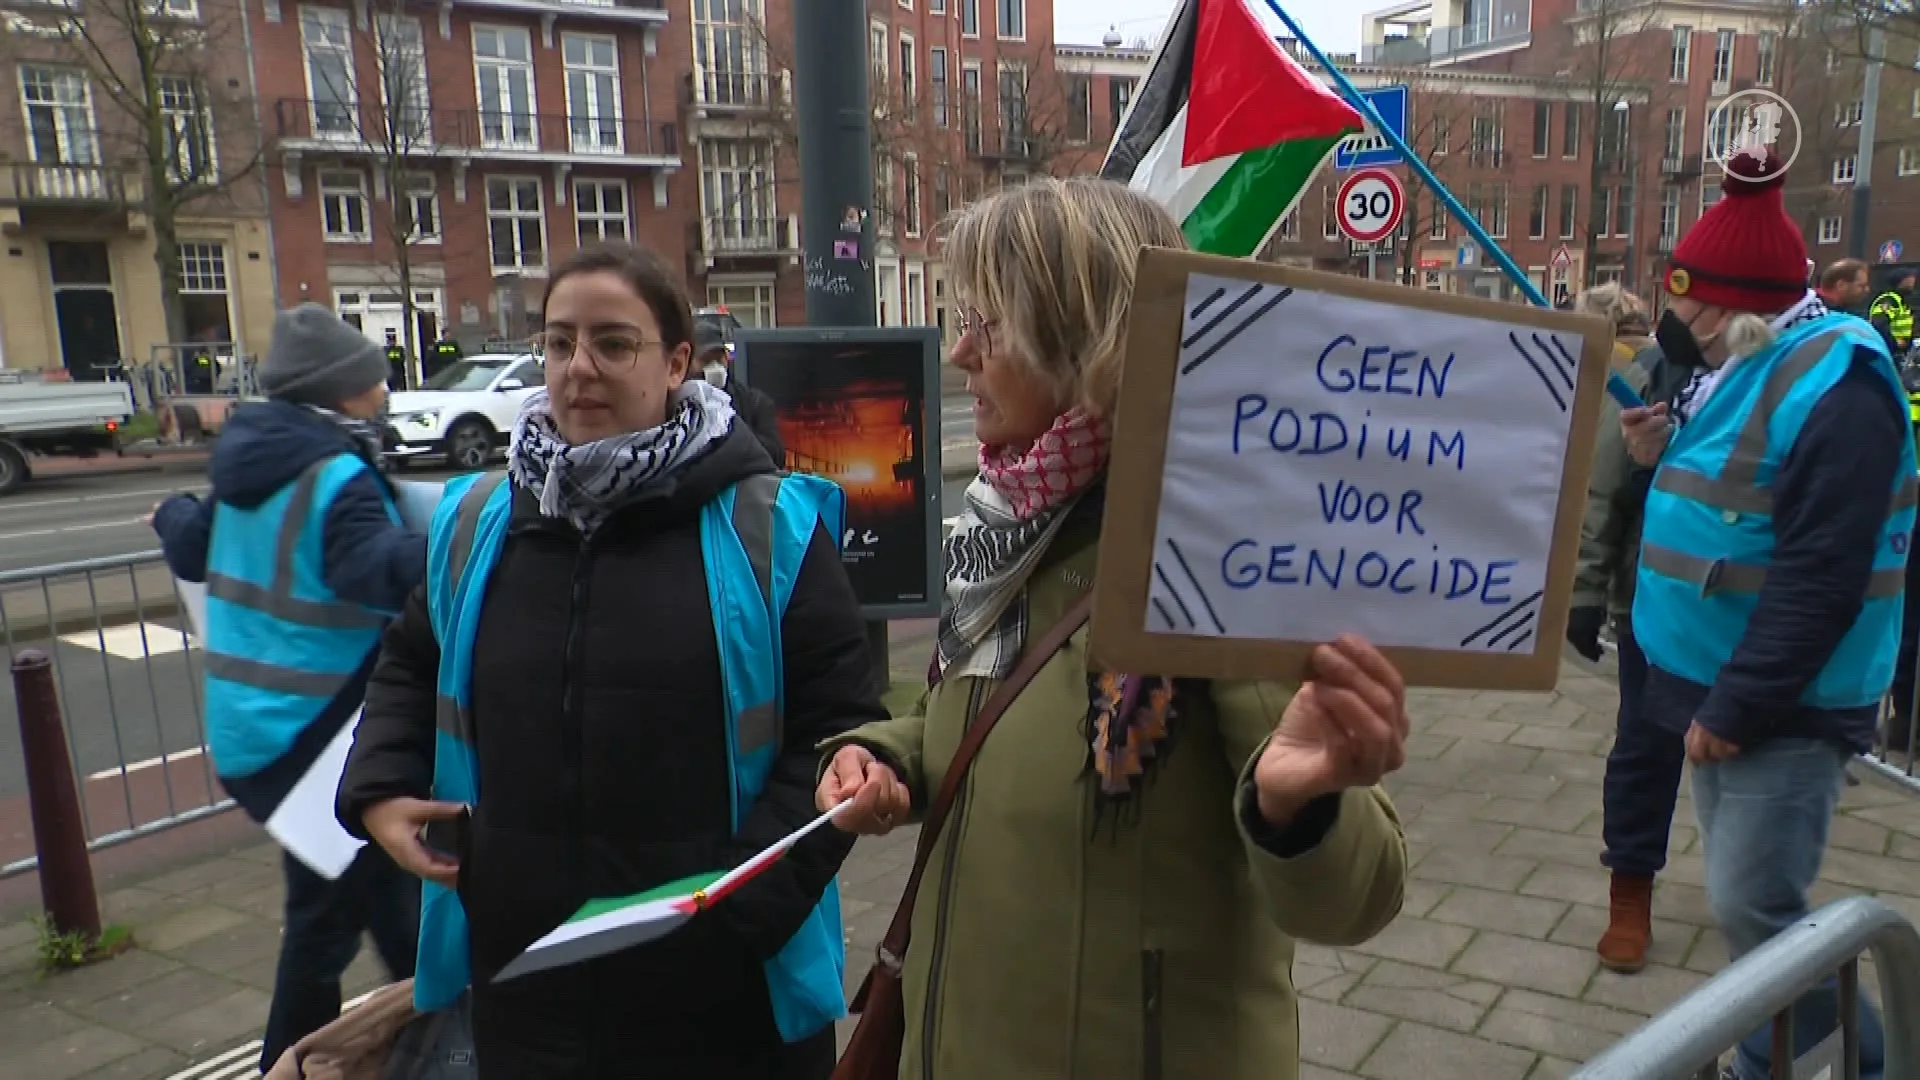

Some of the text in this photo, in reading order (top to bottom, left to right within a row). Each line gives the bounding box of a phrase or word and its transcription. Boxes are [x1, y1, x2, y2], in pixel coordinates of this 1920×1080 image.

[1349, 191, 1391, 221] 30
[1315, 334, 1455, 399] GEEN
[1317, 479, 1426, 536] VOOR
